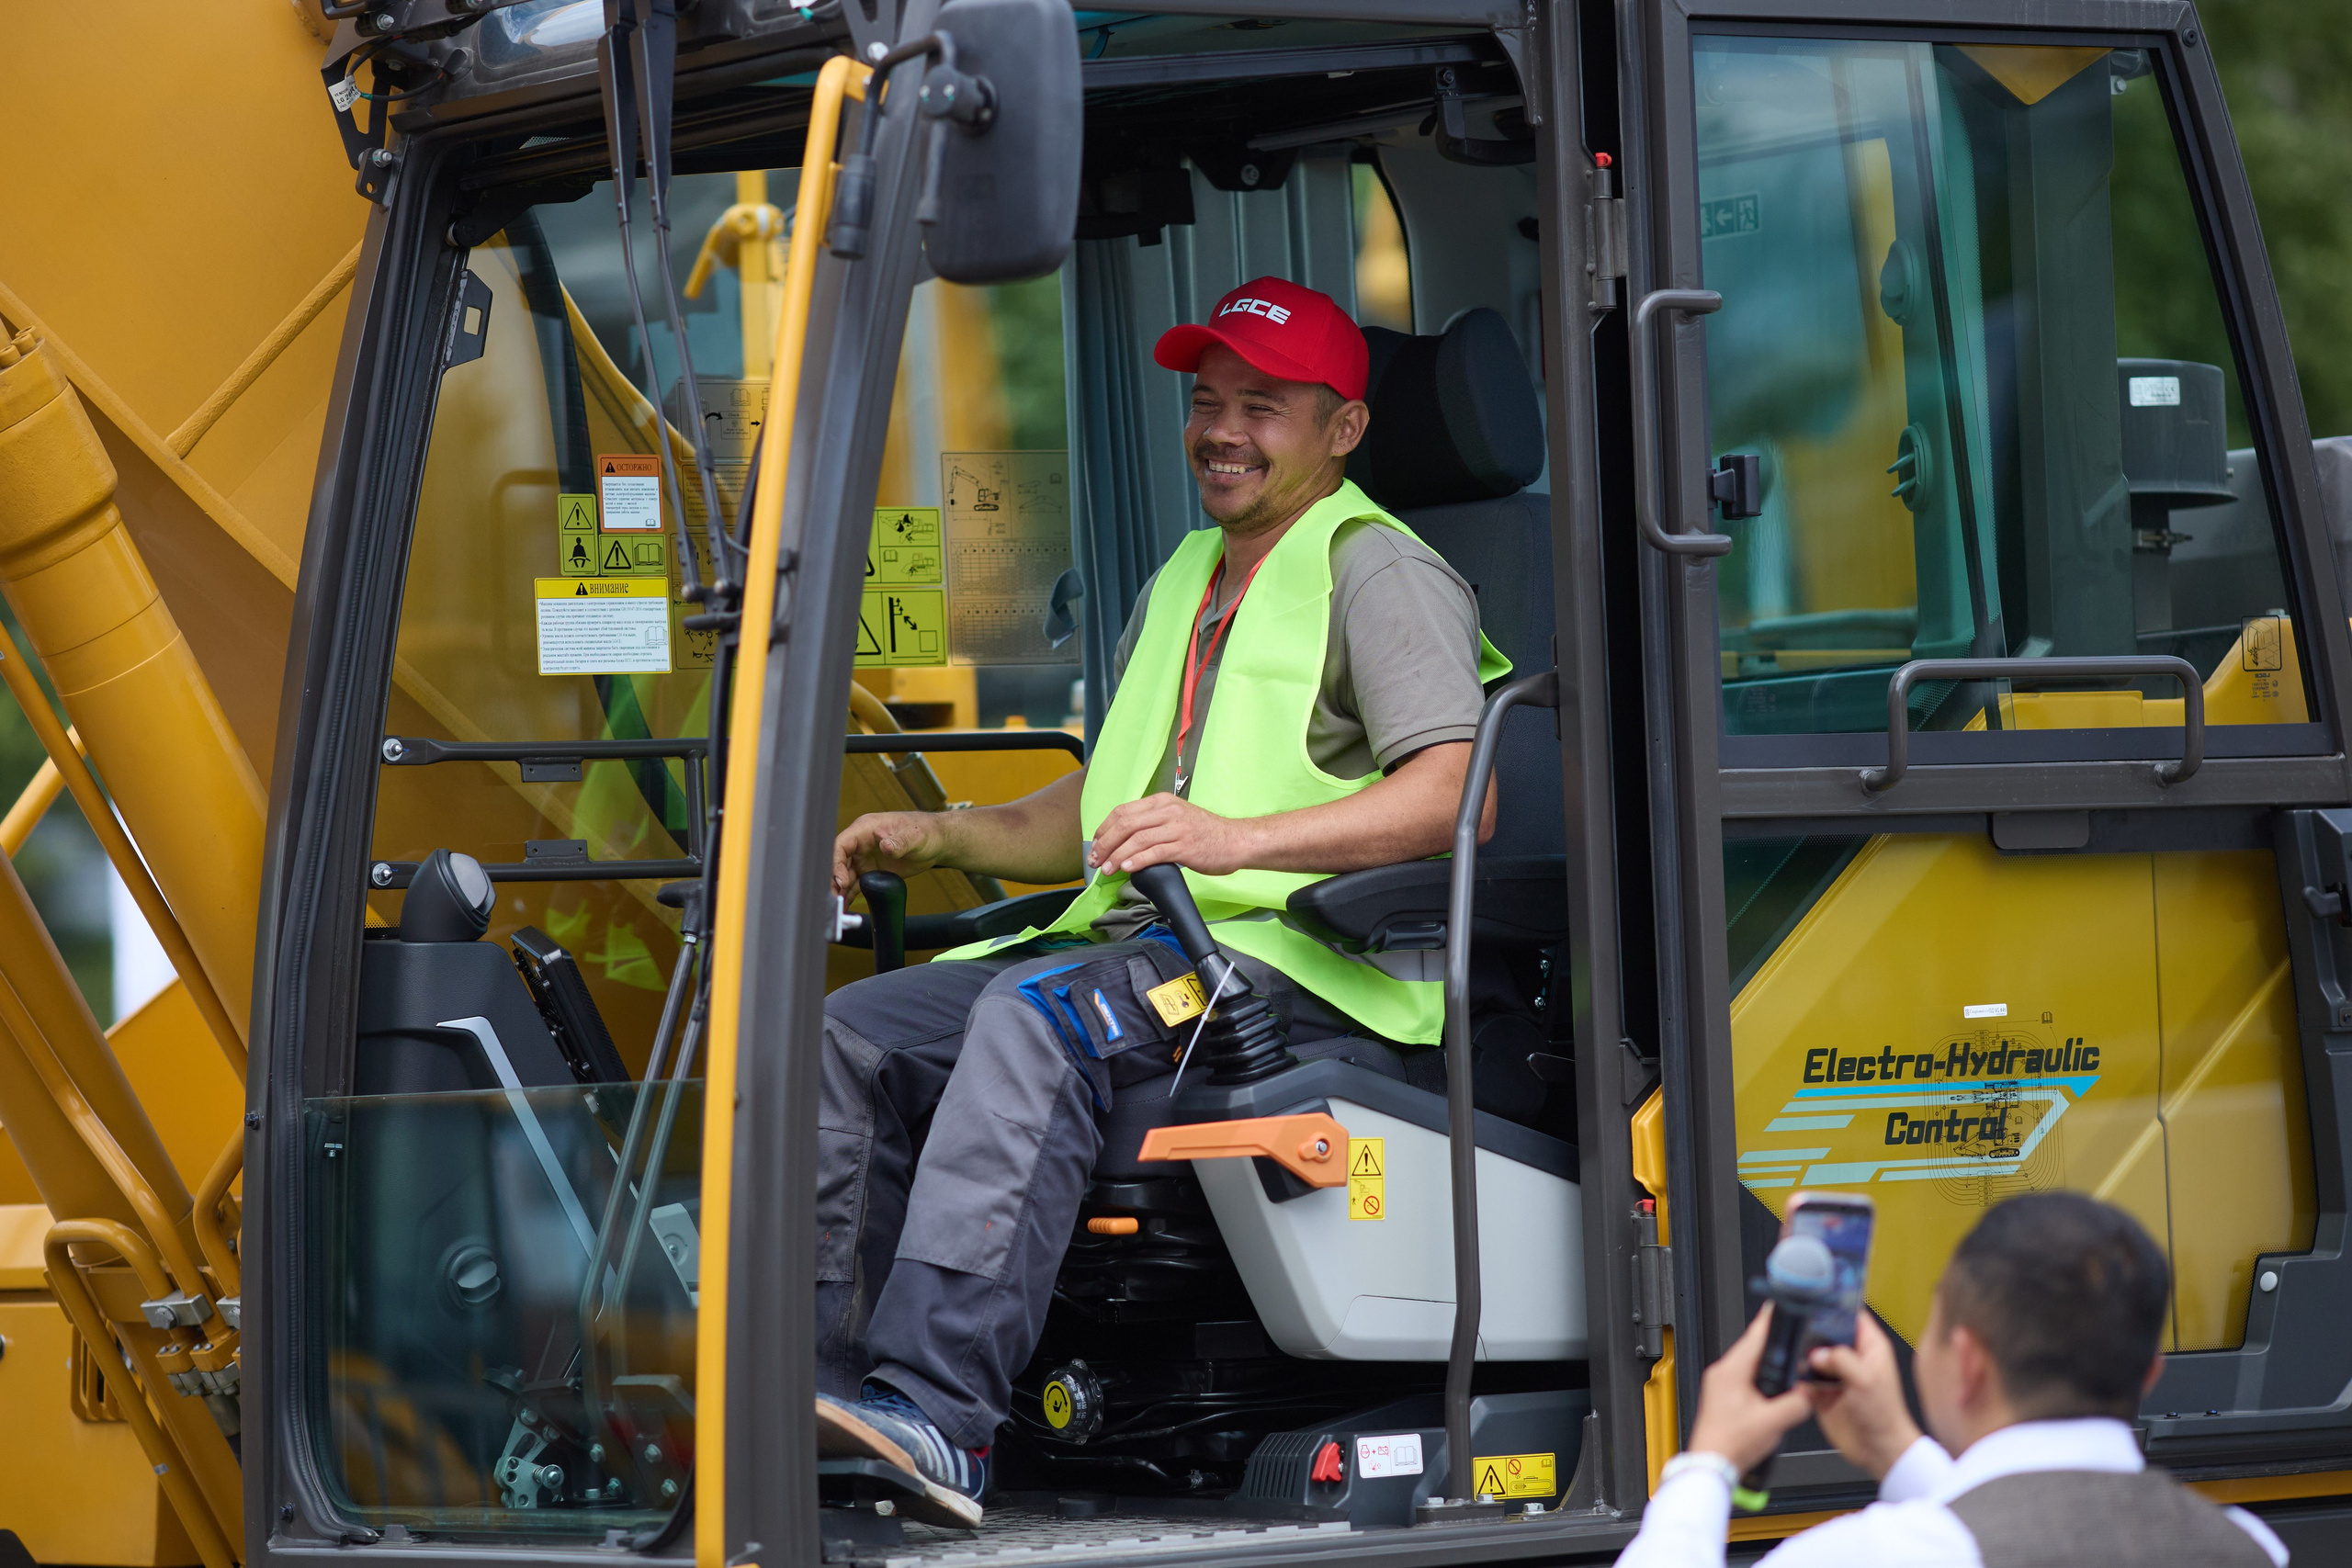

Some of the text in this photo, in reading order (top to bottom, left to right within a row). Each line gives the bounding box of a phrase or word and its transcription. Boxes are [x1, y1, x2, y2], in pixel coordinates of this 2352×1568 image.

[1218, 298, 1292, 325] LGCE
[1803, 1037, 2100, 1083] Electro-Hydraulic
[1883, 1107, 2007, 1145] Control
